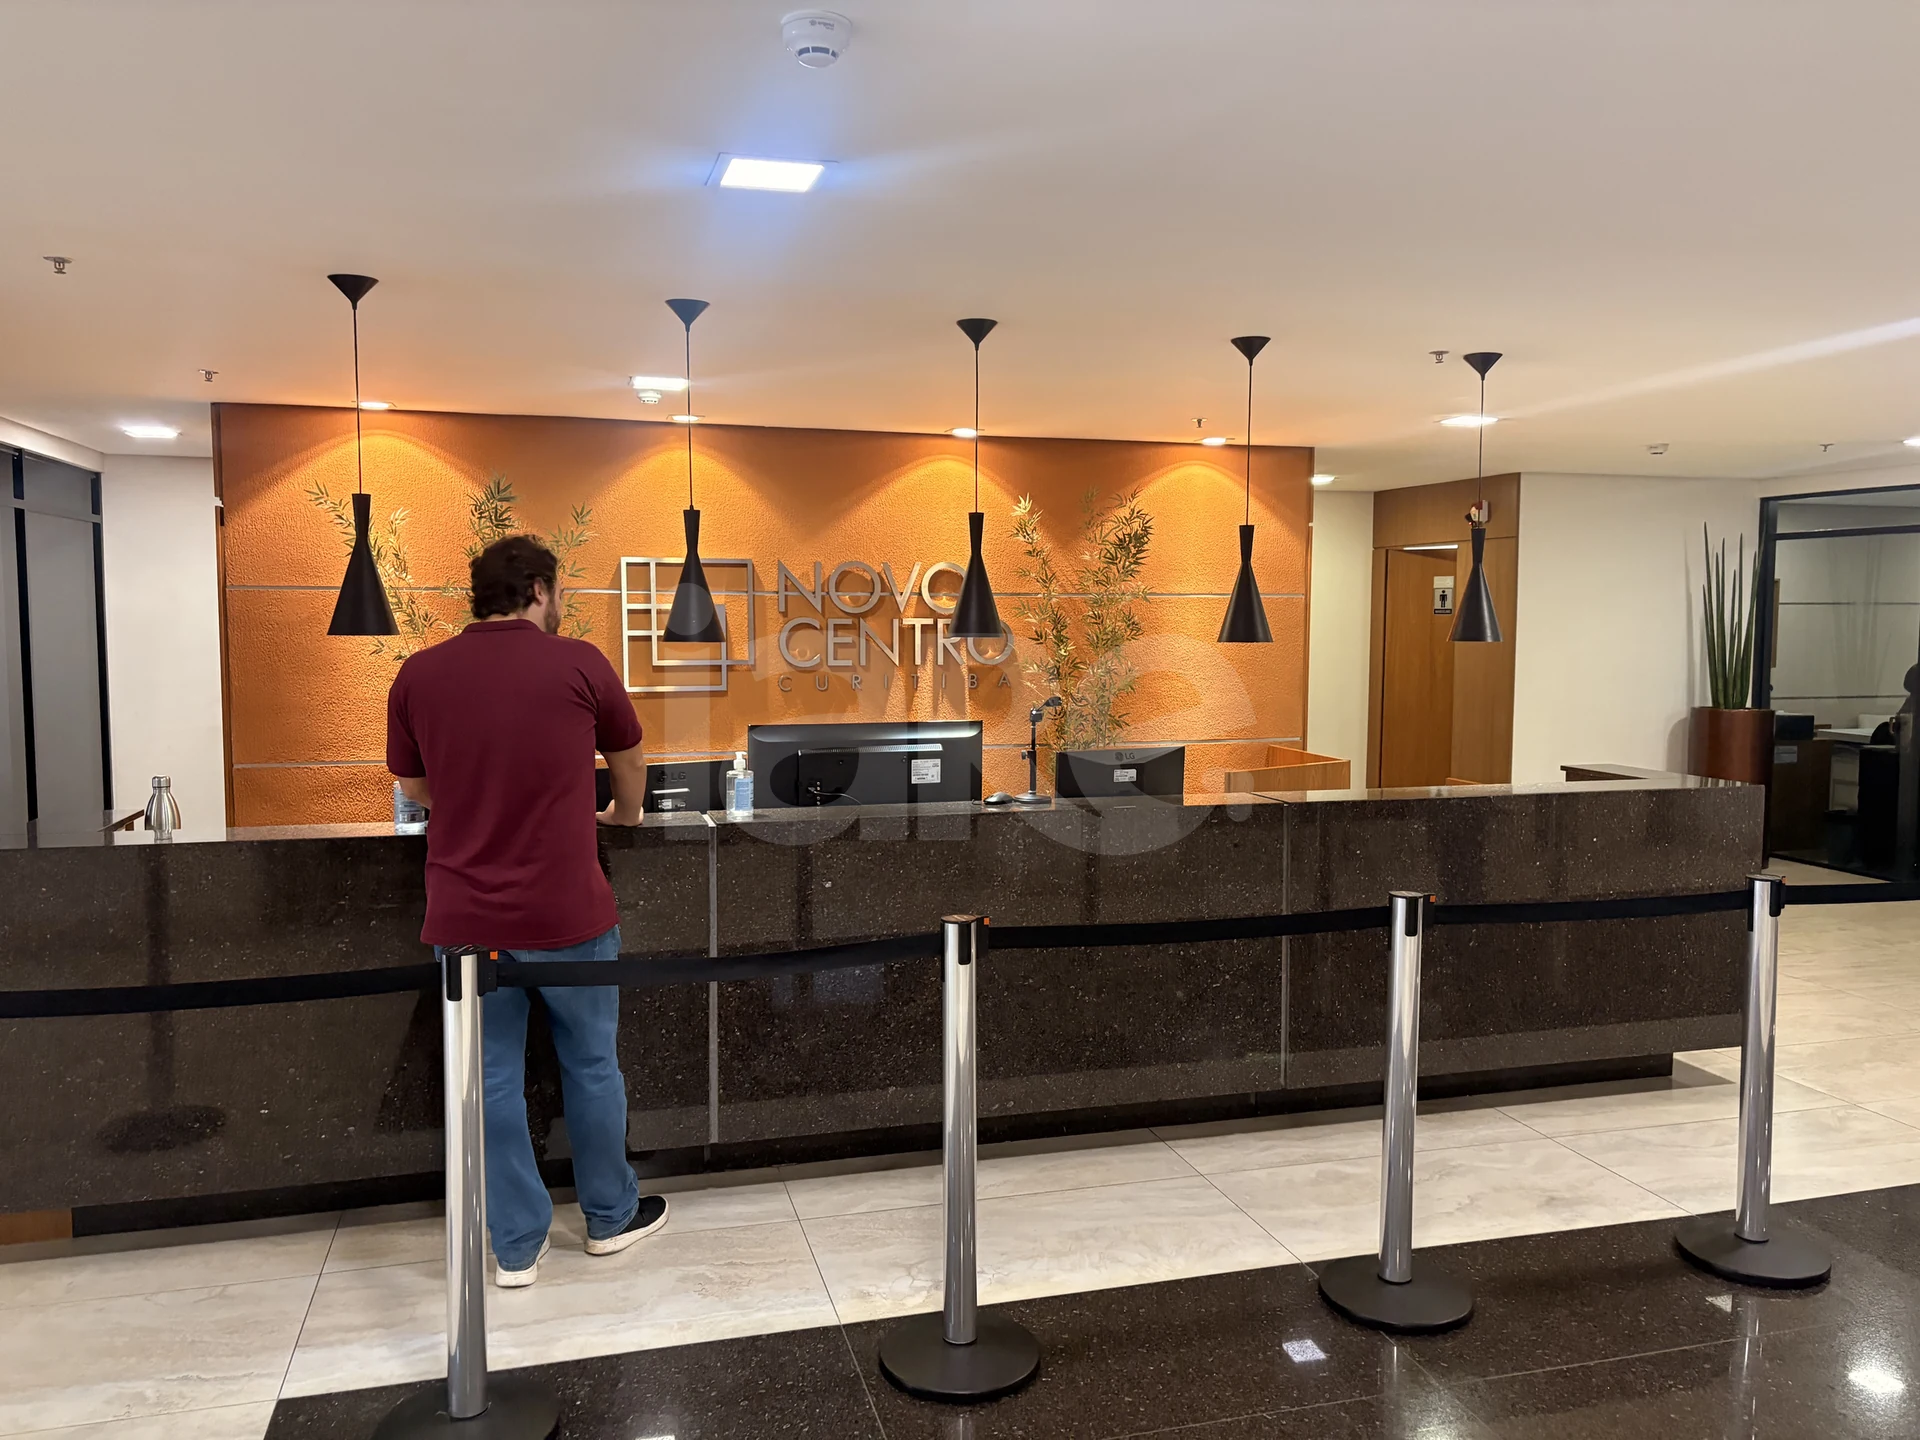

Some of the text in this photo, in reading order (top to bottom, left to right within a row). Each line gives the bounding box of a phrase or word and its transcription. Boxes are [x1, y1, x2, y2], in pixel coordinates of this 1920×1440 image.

[777, 559, 968, 615] NOVO
[778, 616, 1015, 668] CENTRO
[777, 673, 1011, 692] CURITIBA
[1124, 752, 1136, 760] LG
[670, 771, 687, 782] LG
